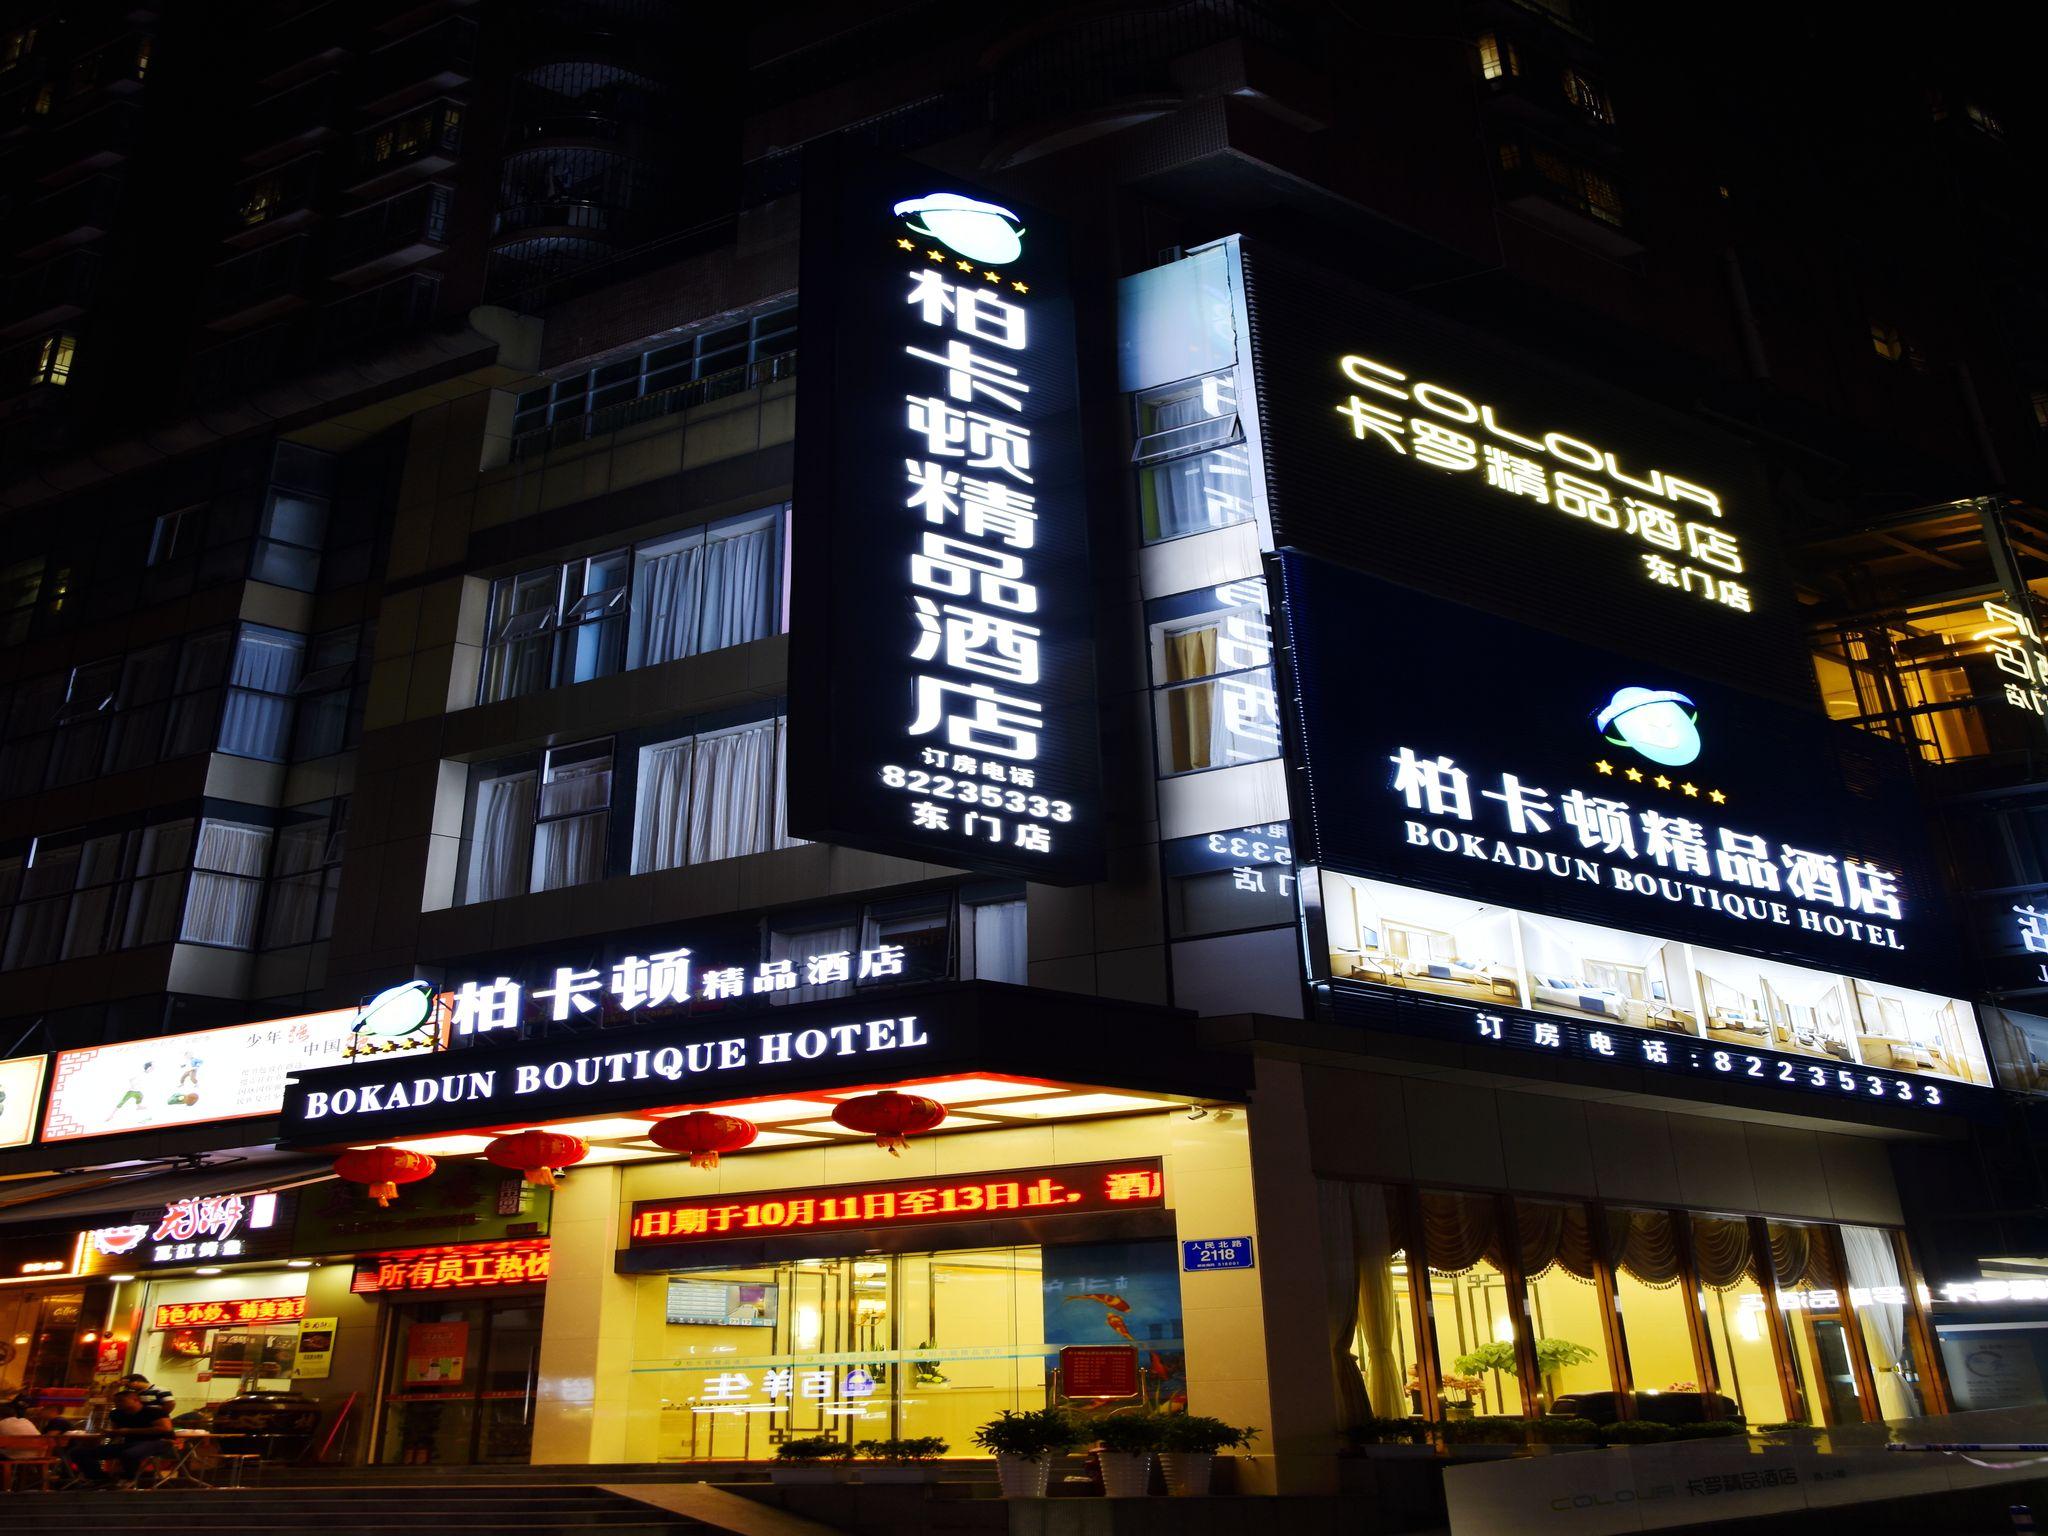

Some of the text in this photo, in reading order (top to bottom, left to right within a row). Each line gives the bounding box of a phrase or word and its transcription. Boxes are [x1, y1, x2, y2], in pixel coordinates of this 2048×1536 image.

[1340, 354, 1723, 518] COLOUR
[905, 268, 1041, 762] 柏卡顿精品酒店
[1336, 395, 1744, 575] 卡罗精品酒店
[1641, 553, 1752, 613] 东门店
[881, 764, 1073, 822] 82235333
[921, 746, 1035, 790] 订房电话
[912, 800, 1052, 855] 东门店
[1390, 747, 1903, 920] 柏卡顿精品酒店
[1405, 820, 1905, 951] BOKADUN BOUTIQUE HOTEL
[304, 1070, 496, 1120] BOKADUN
[515, 1039, 747, 1096] BOUTIQUE
[758, 1016, 928, 1064] HOTEL
[1191, 1240, 1242, 1250] 人民北路
[1200, 1248, 1235, 1262] 2118
[1552, 1484, 1676, 1511] COLOUR
[1686, 1467, 1798, 1497] 卡罗精品酒店
